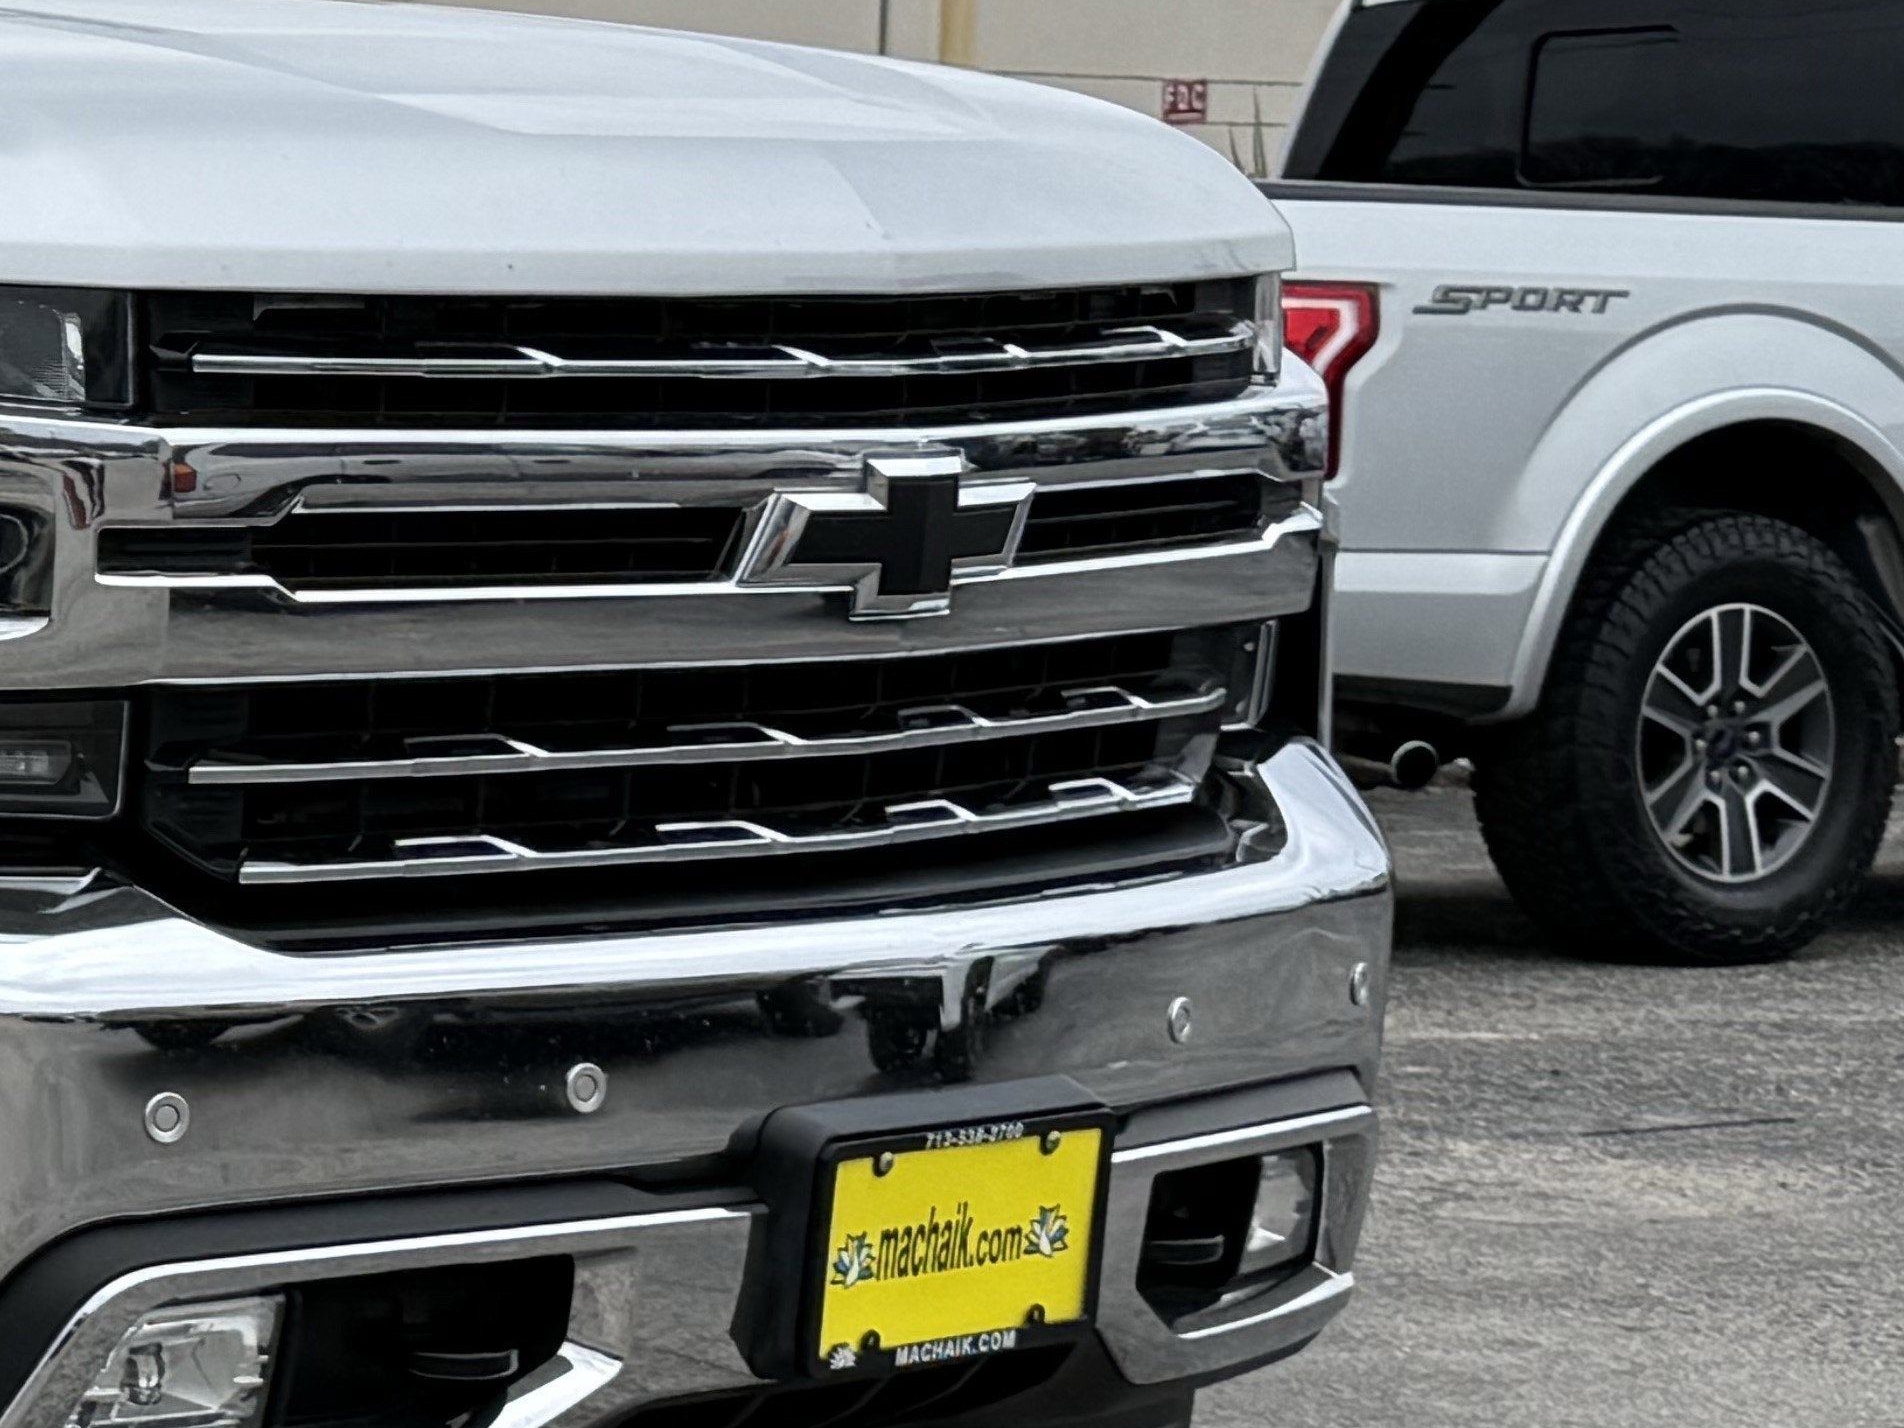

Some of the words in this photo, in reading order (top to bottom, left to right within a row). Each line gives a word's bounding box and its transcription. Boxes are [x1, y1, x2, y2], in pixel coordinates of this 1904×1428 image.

[1412, 284, 1630, 315] SPORT
[875, 1201, 1024, 1281] machaik.com
[894, 1329, 1017, 1367] MACHAIK.COM
